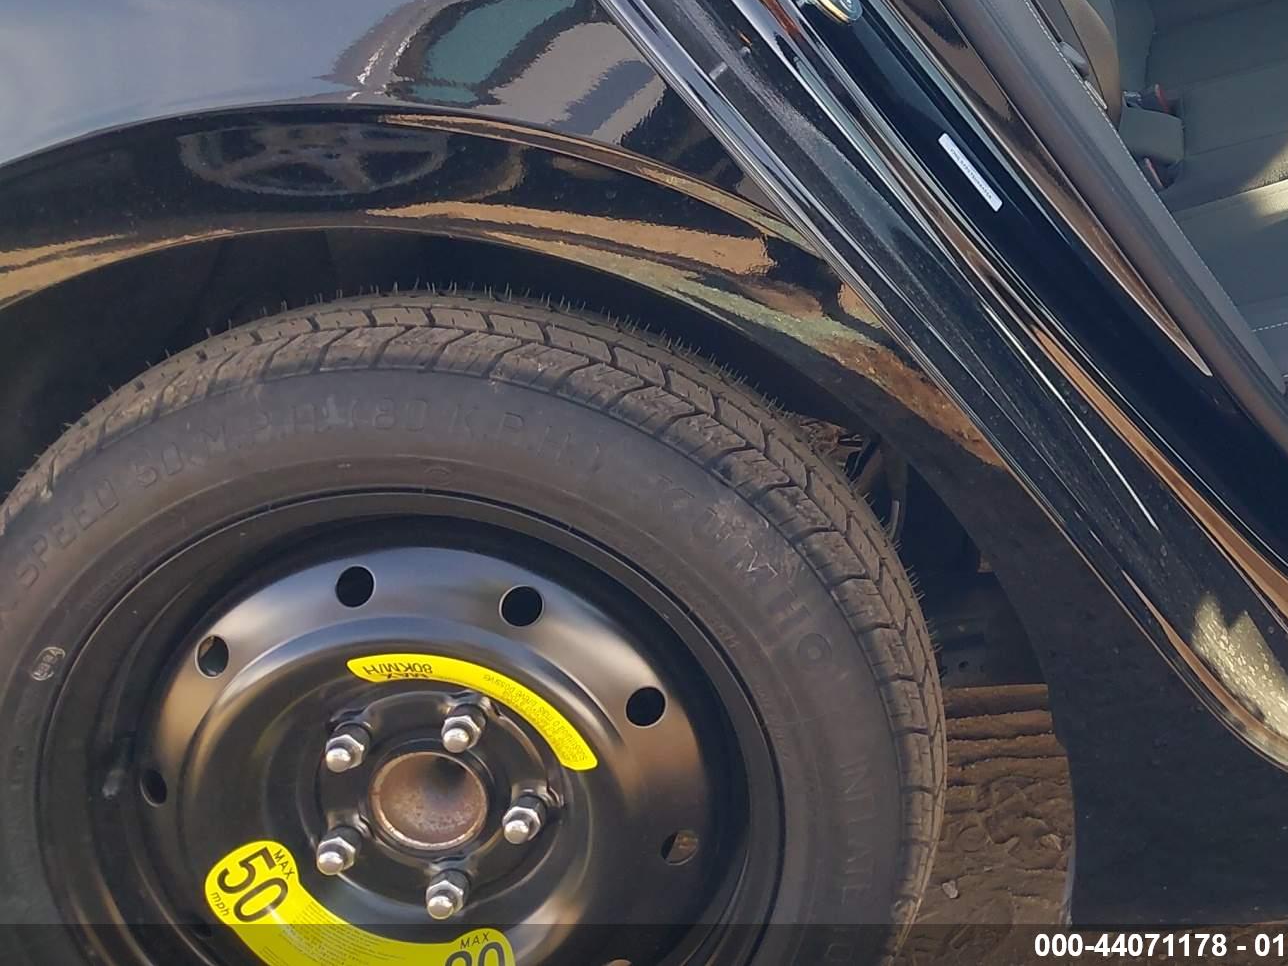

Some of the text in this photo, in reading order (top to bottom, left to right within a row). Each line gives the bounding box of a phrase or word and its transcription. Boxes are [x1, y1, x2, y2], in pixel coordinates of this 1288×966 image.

[362, 661, 434, 675] 80KM/H
[274, 849, 295, 880] MAX
[217, 847, 288, 923] 50
[210, 891, 231, 917] mph
[460, 931, 490, 950] MAX
